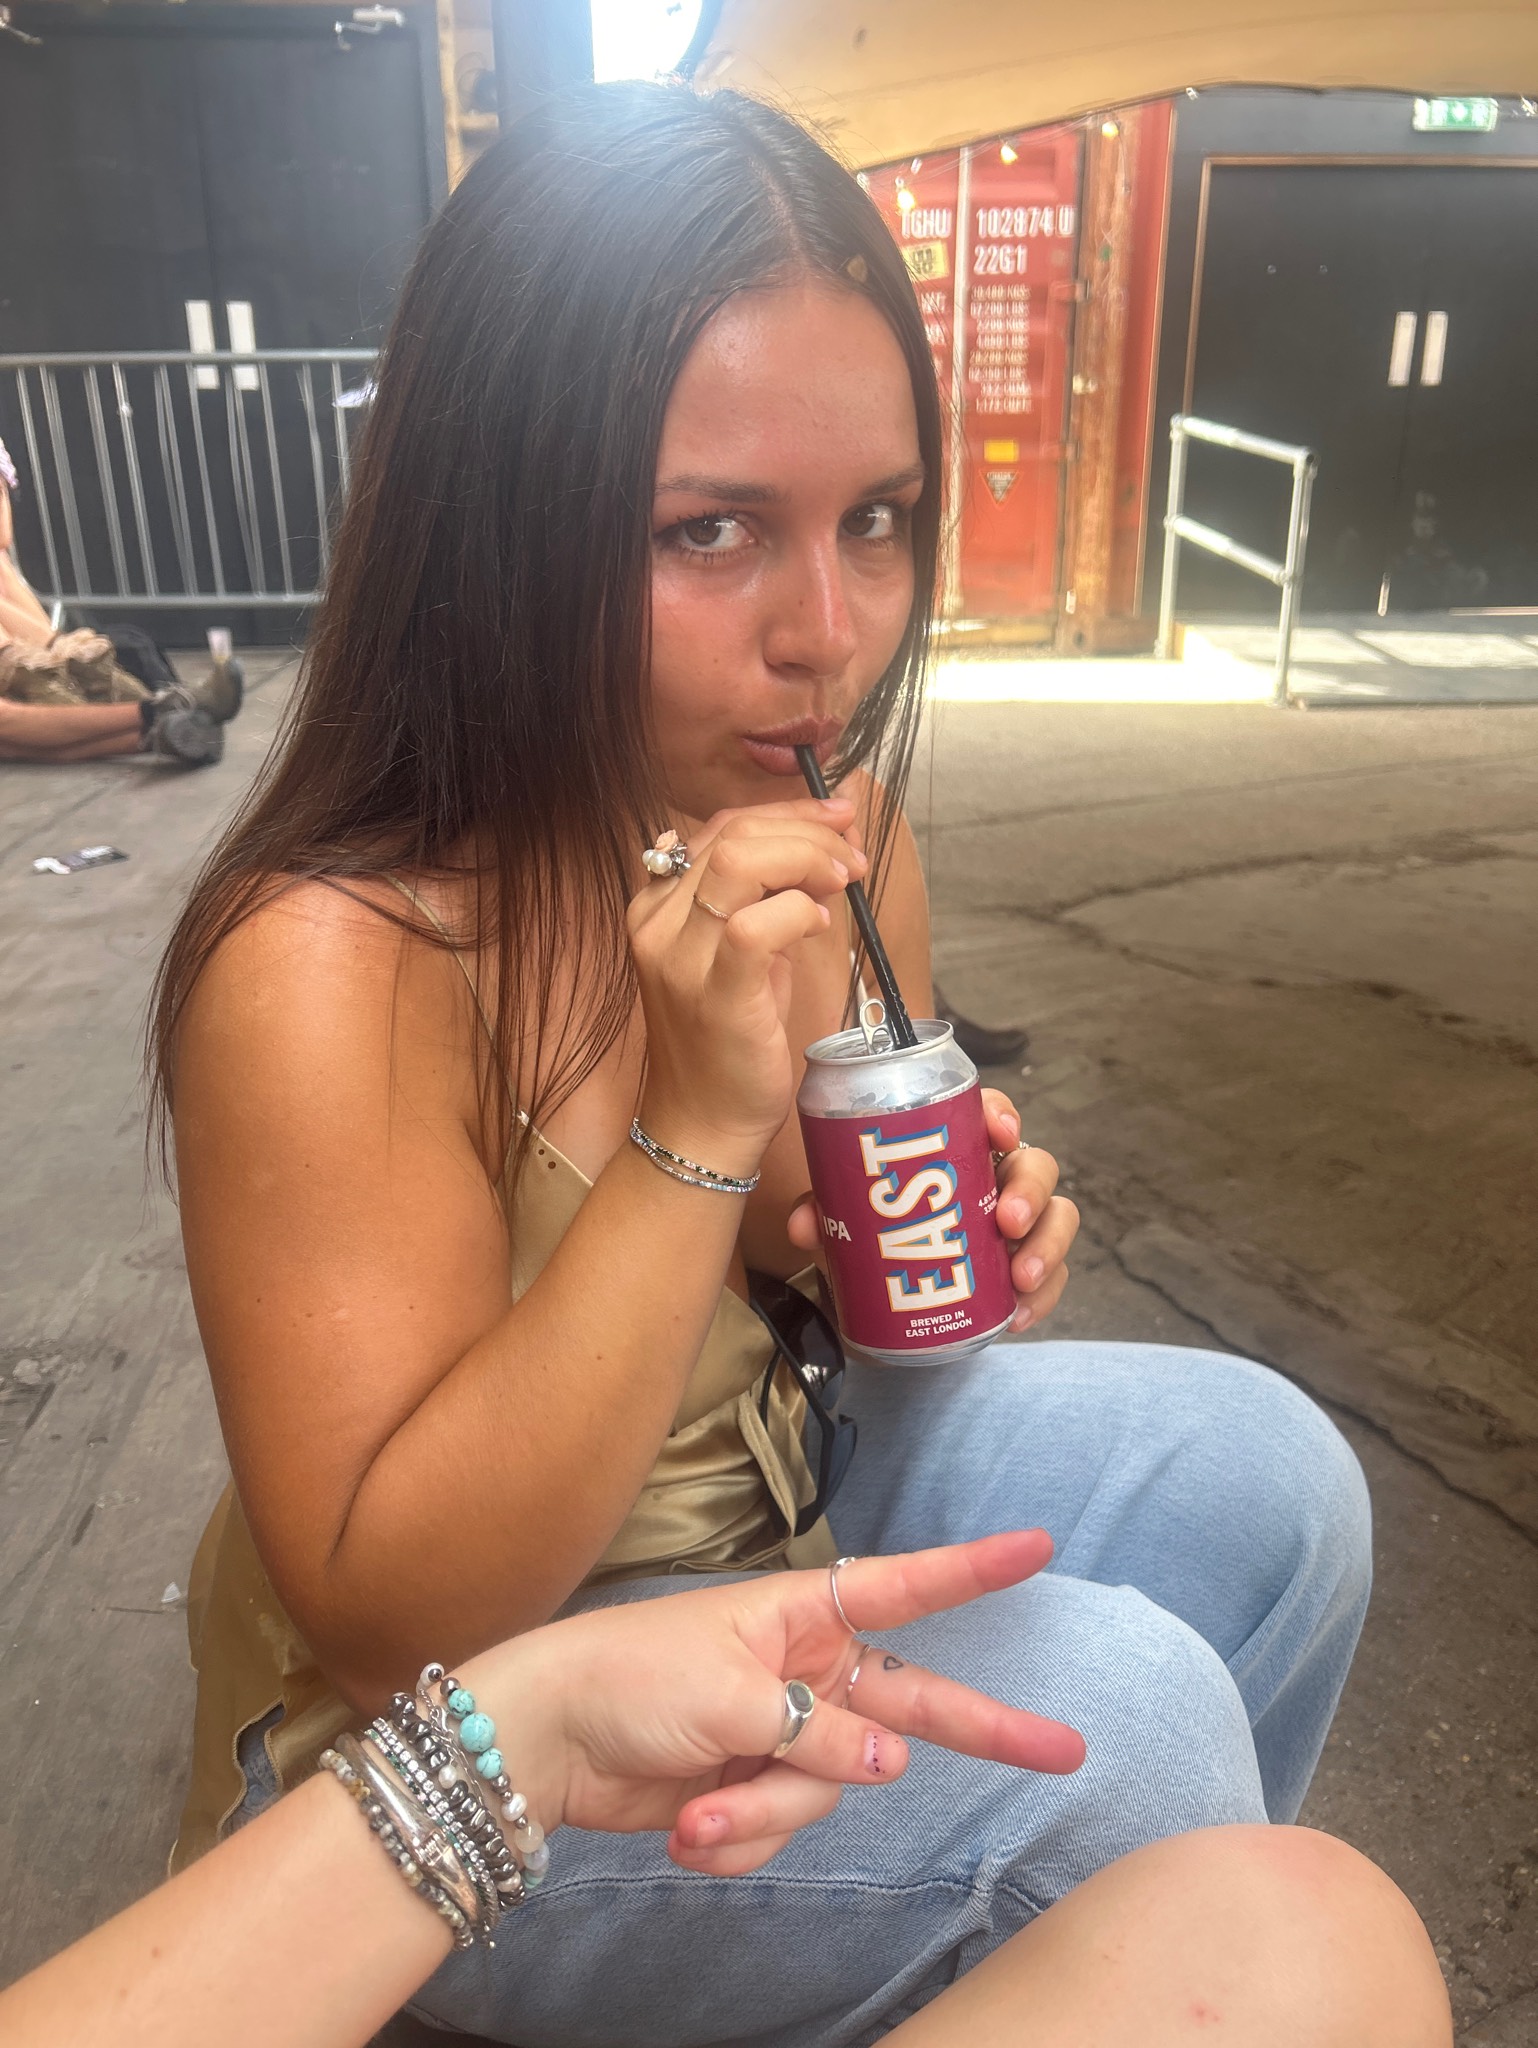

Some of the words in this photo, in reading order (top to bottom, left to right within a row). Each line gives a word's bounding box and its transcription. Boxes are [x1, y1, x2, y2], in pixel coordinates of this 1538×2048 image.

[976, 207, 1054, 238] 102874
[973, 244, 1028, 275] 22G1
[822, 1215, 852, 1242] IPA
[859, 1124, 976, 1313] EAST
[905, 1327, 930, 1338] EAST
[933, 1317, 973, 1335] LONDON
[910, 1313, 952, 1328] BREWED
[954, 1309, 965, 1320] IN
